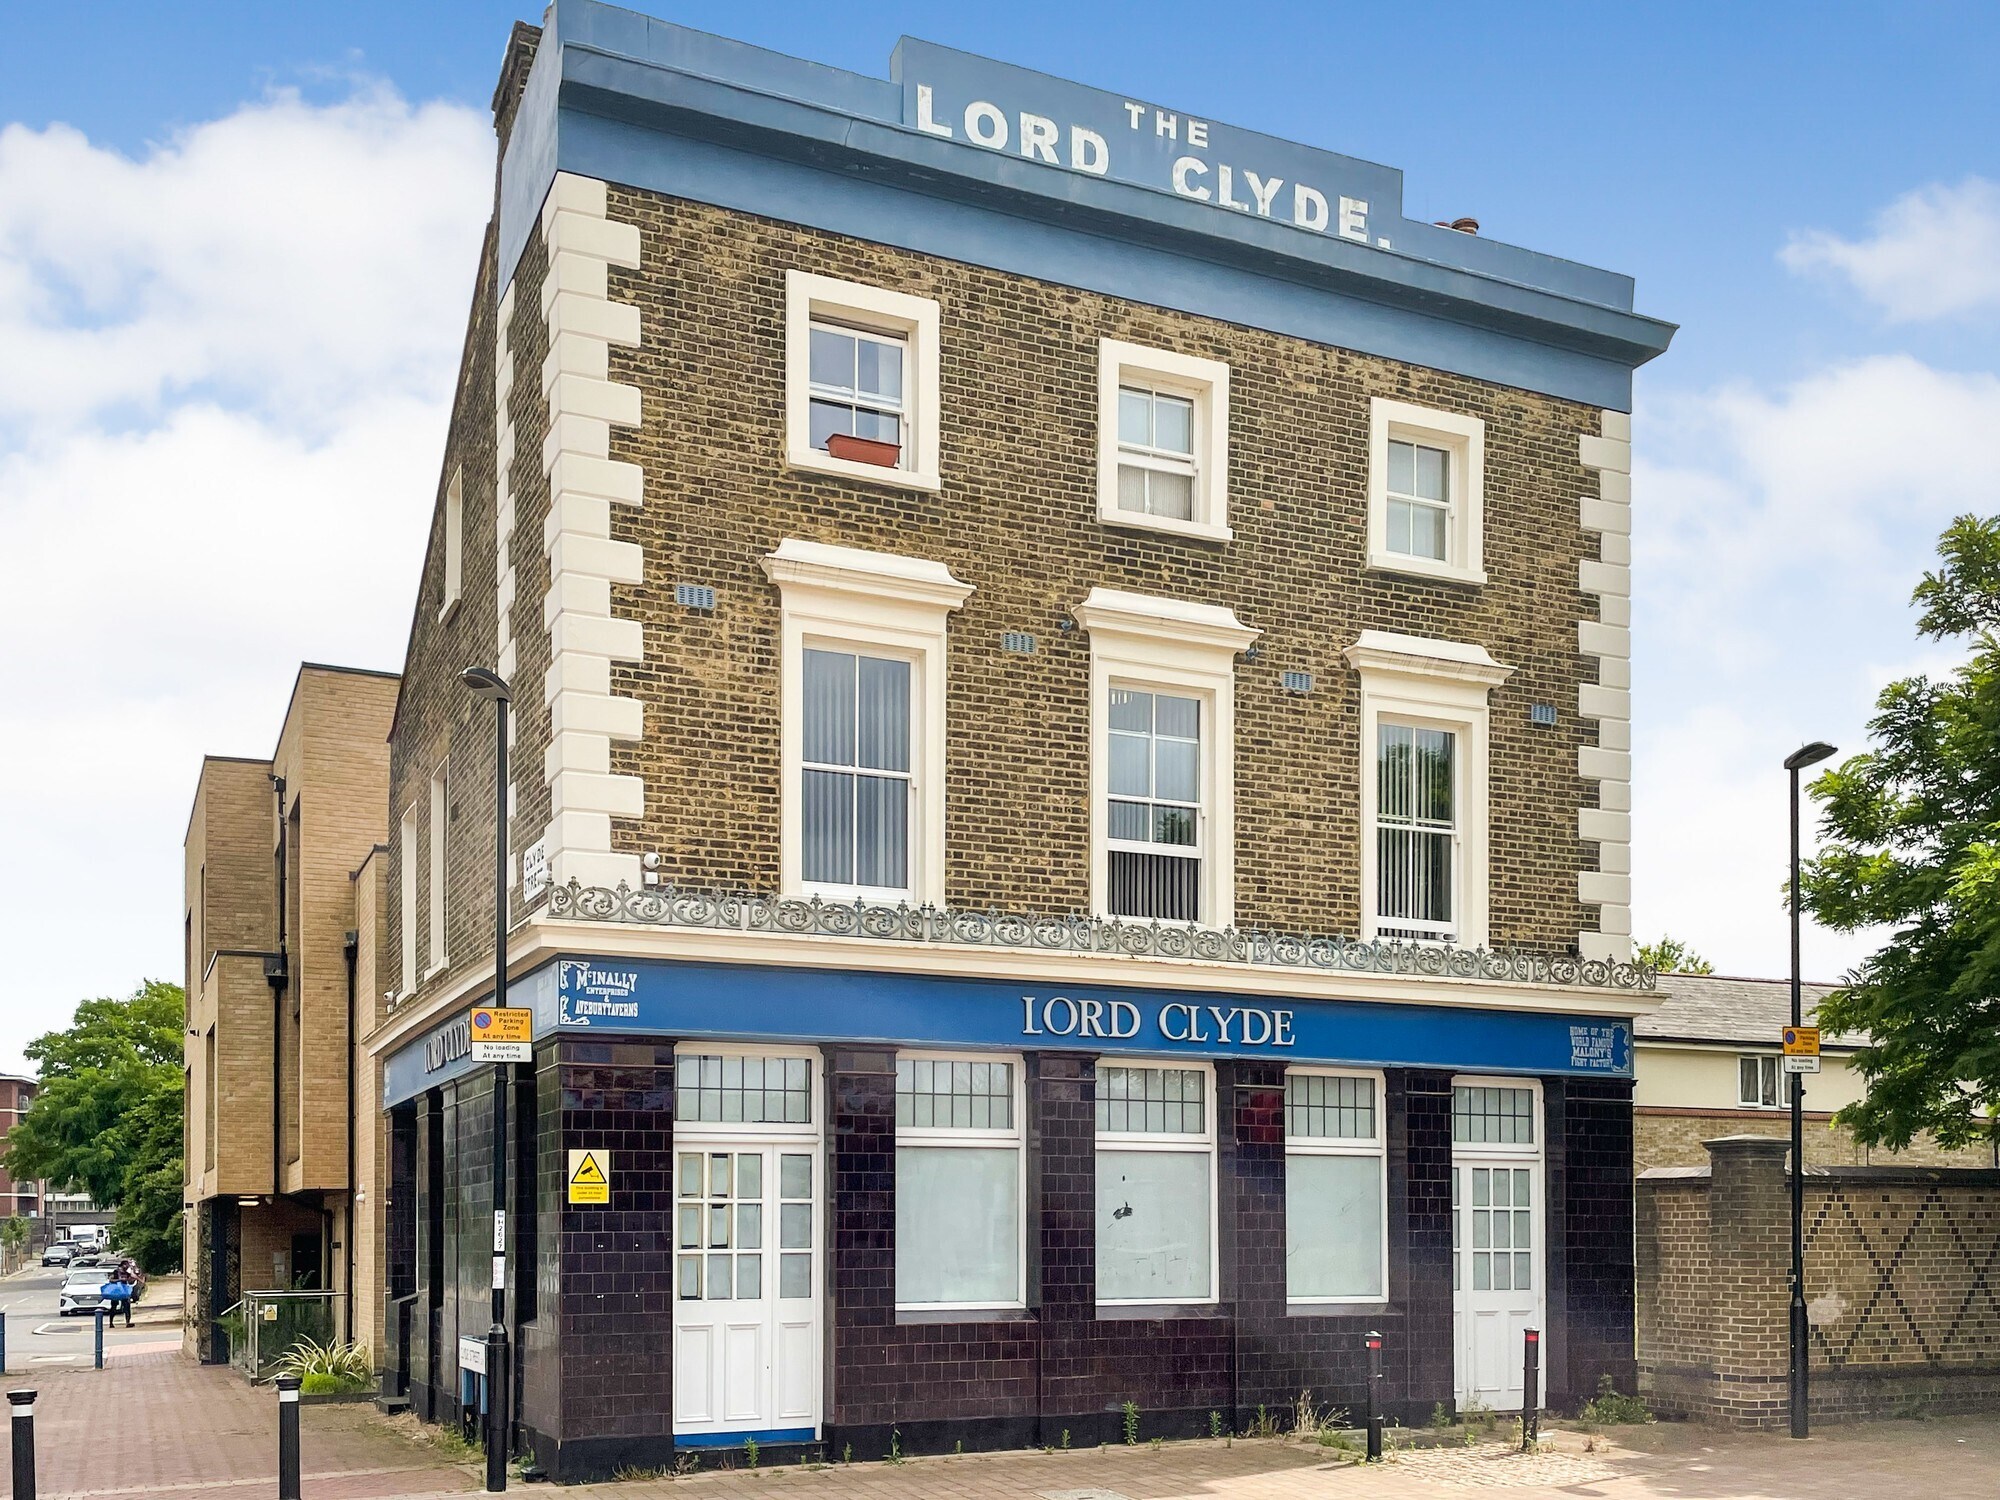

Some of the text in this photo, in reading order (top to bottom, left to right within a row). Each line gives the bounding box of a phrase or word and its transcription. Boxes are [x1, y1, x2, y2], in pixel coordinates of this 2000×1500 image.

[1124, 102, 1208, 149] THE
[917, 83, 1391, 249] LORD CLYDE.
[493, 1010, 529, 1018] Restricted
[604, 994, 610, 1003] &
[498, 1017, 524, 1025] Parking
[1022, 996, 1296, 1046] LORD CLYDE
[424, 1035, 443, 1074] LORD
